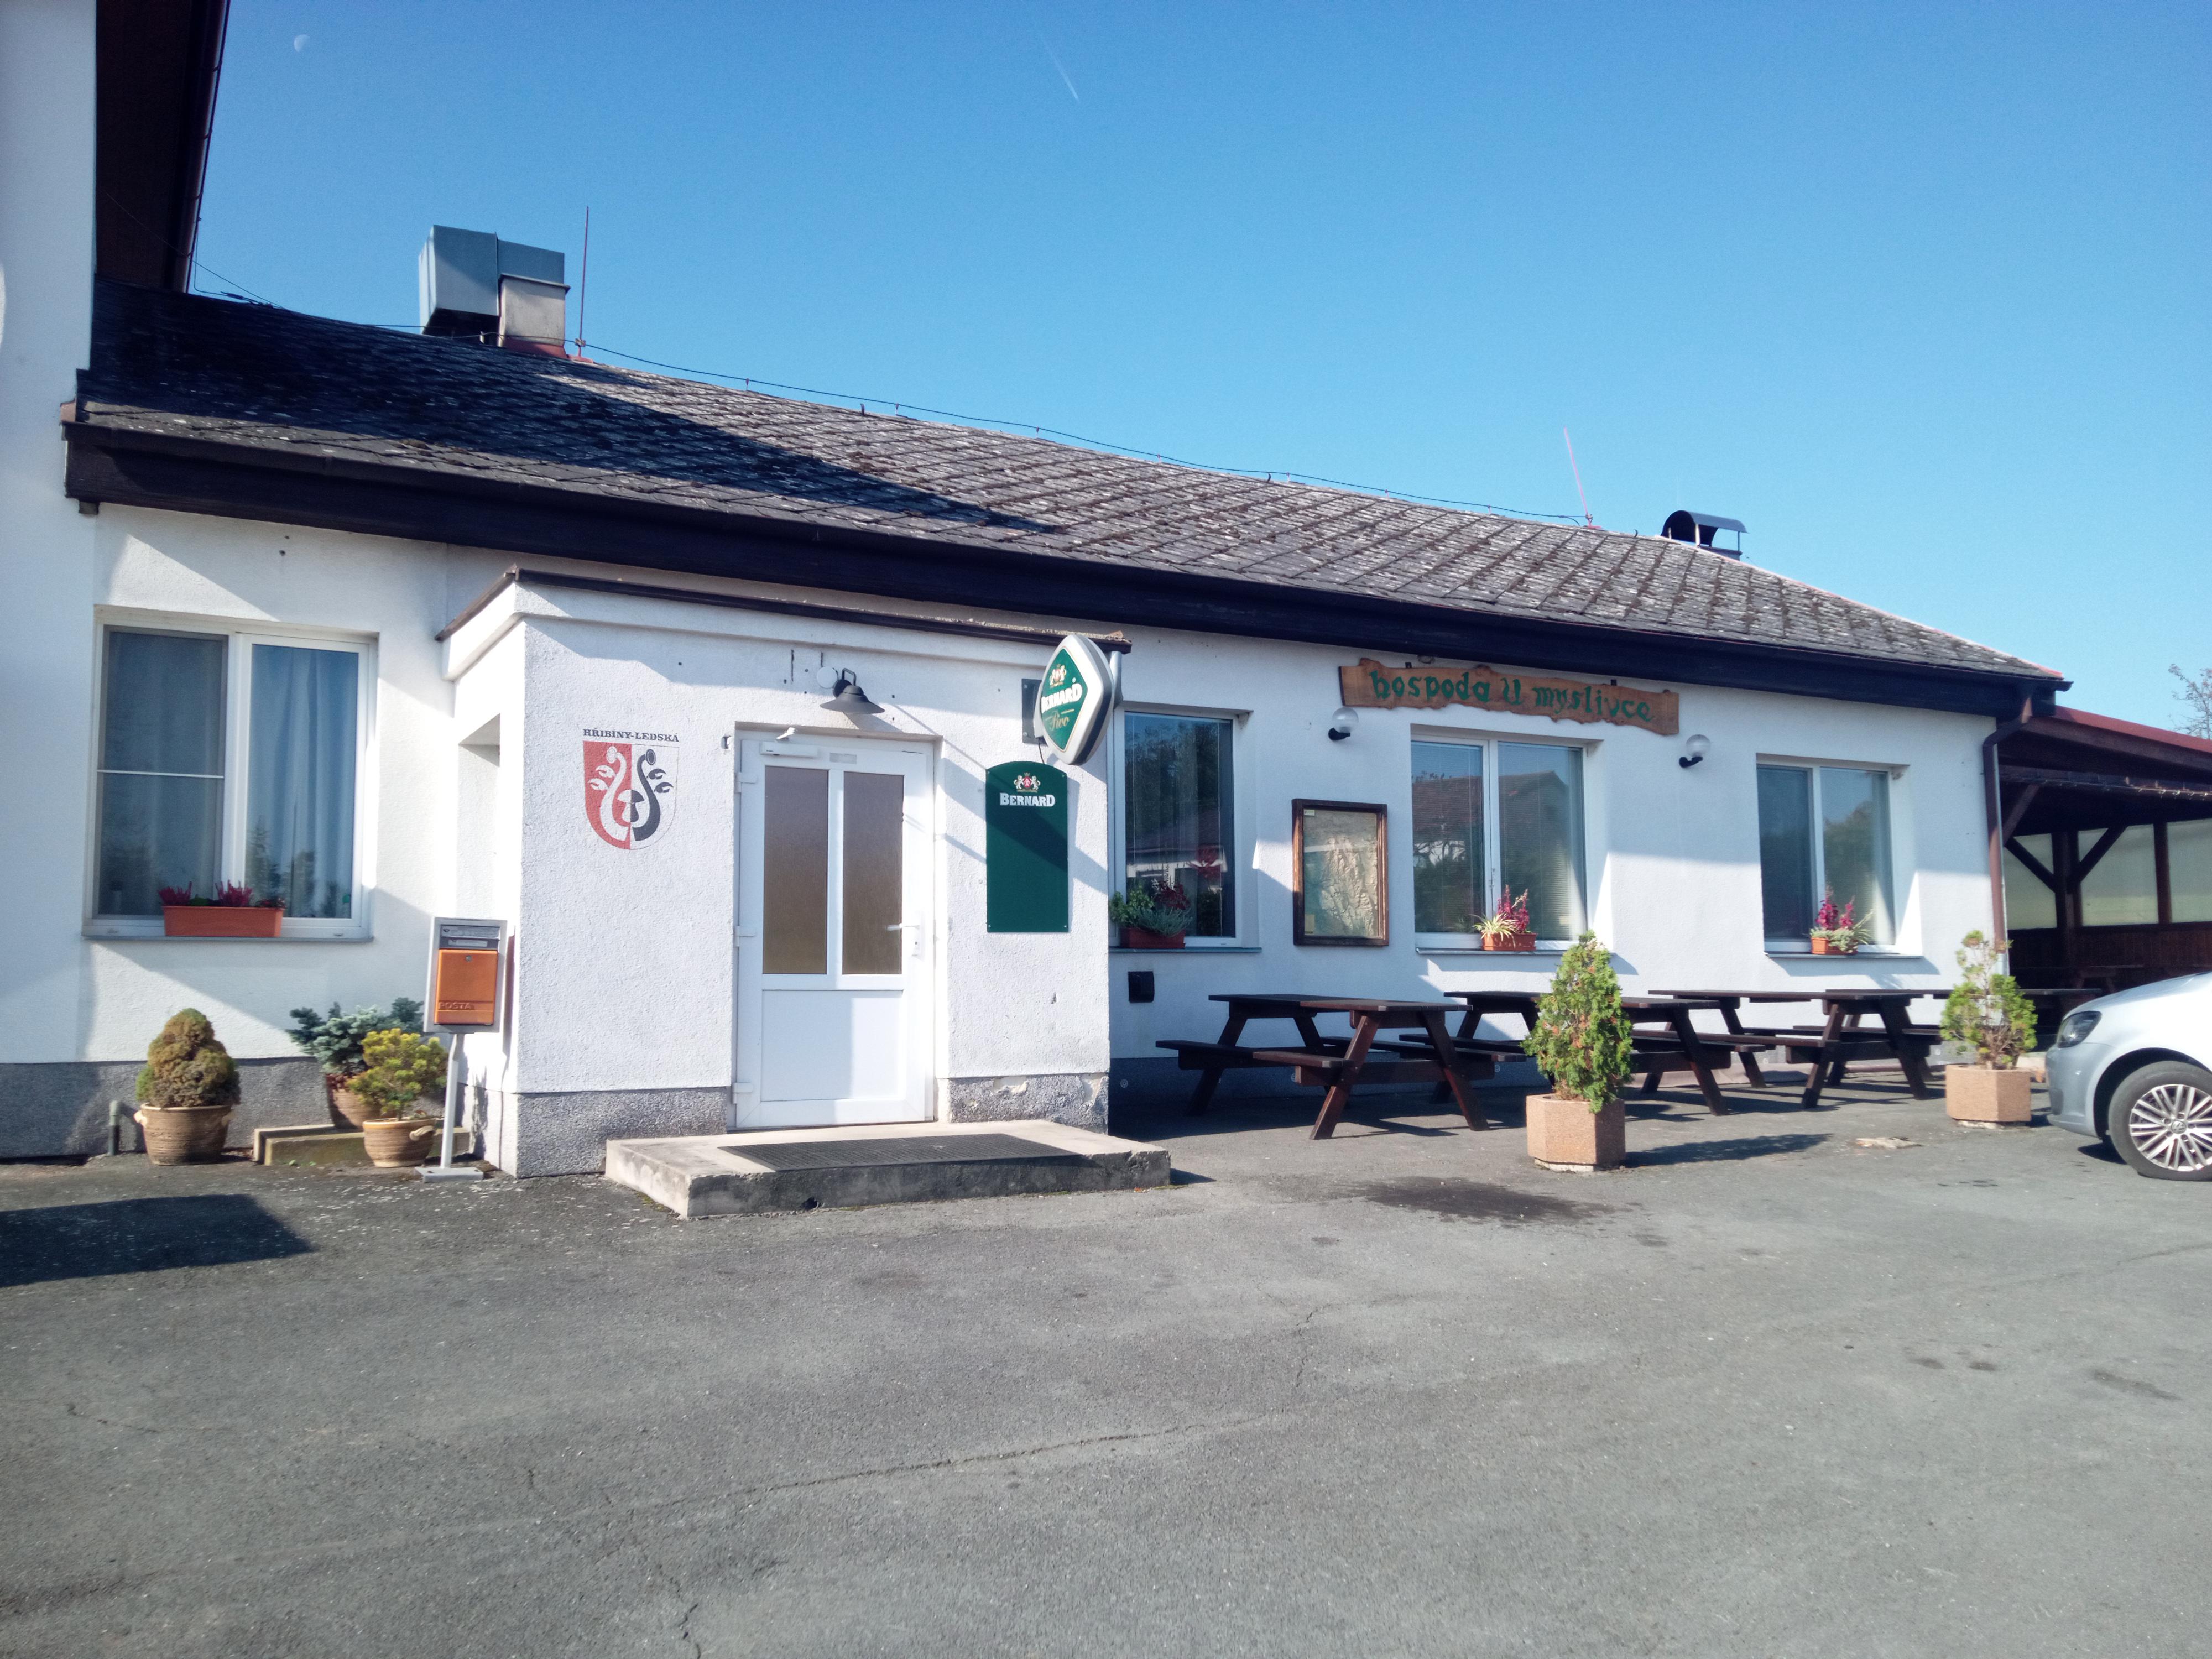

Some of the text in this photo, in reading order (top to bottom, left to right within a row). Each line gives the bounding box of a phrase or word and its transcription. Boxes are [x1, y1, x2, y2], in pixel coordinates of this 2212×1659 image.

[1041, 683, 1082, 713] BERNARD
[1369, 670, 1655, 722] hospoda U myslivce
[583, 728, 679, 742] HŘIBINY-LEDSKÁ
[1000, 792, 1055, 807] BERNARD
